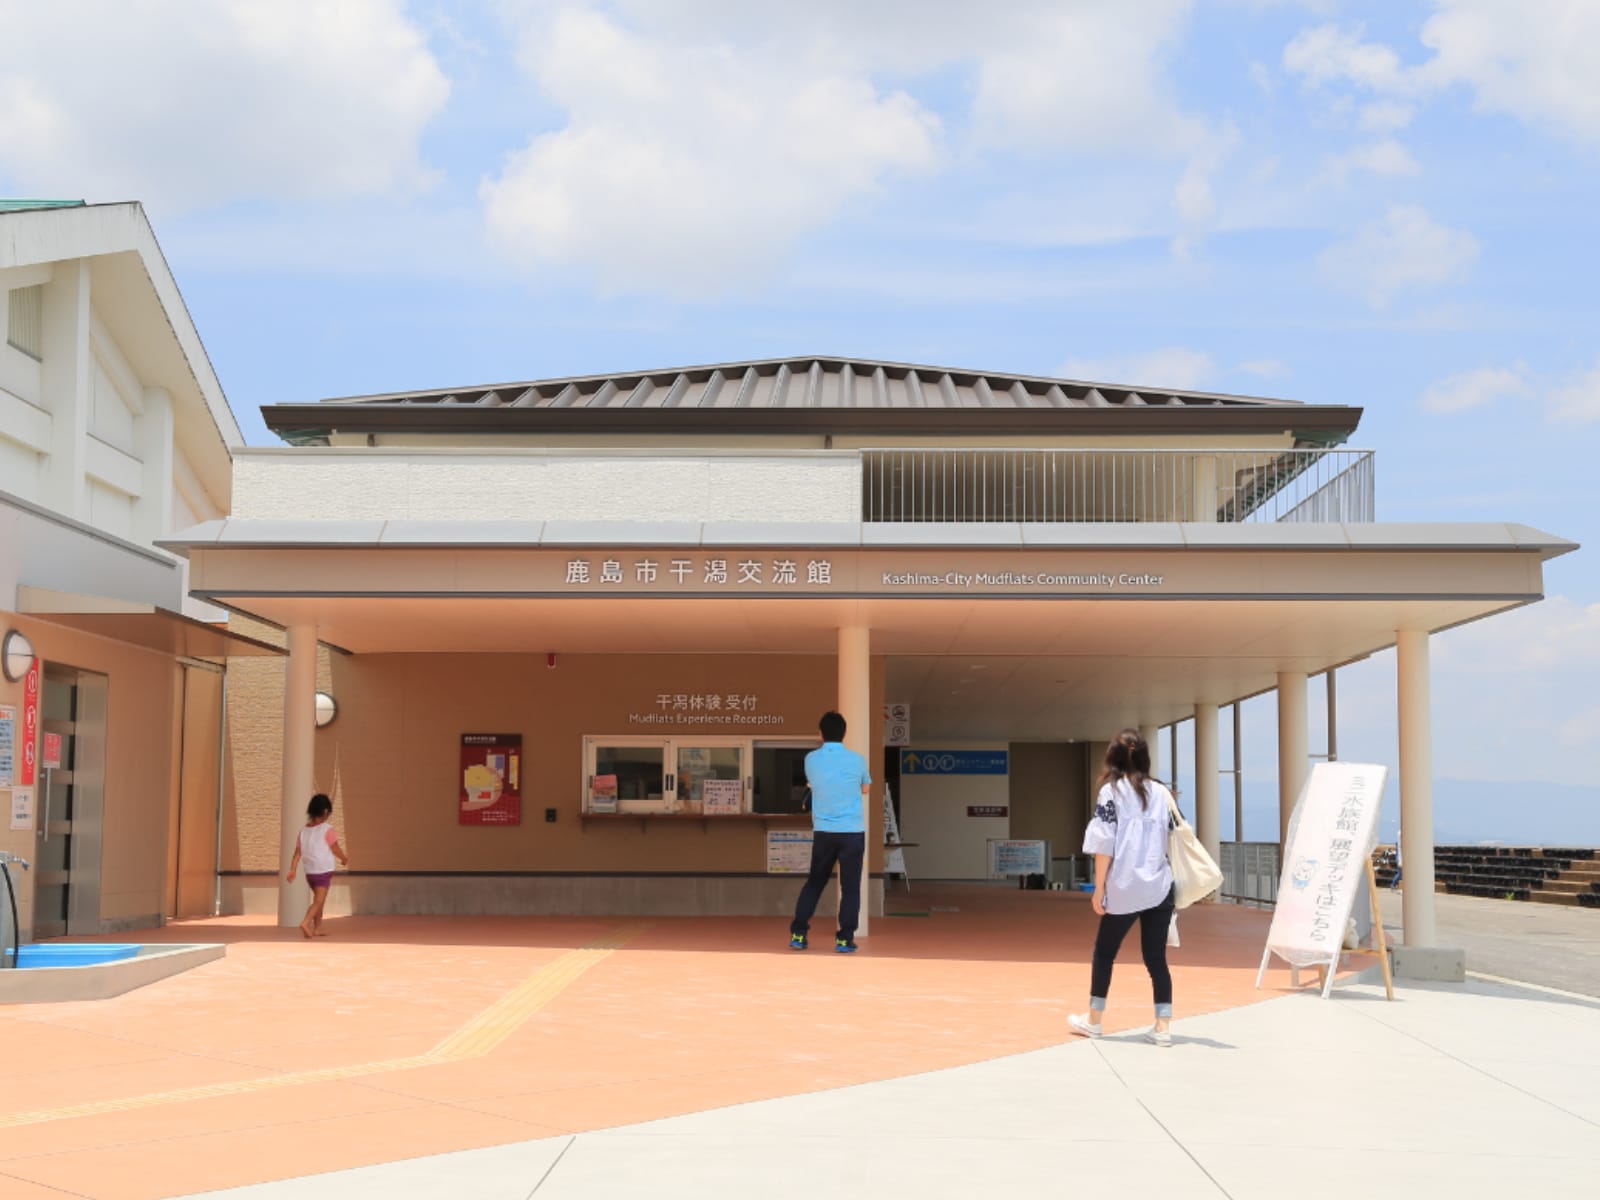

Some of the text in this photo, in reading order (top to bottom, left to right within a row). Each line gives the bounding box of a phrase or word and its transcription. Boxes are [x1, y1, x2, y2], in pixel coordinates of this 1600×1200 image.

[565, 559, 833, 585] 鹿島市干潟交流館
[882, 572, 1164, 588] Kashima-City Mudflats Community Center
[656, 694, 758, 711] 干潟体験 受付
[629, 713, 784, 726] Mudflats Experience Reception
